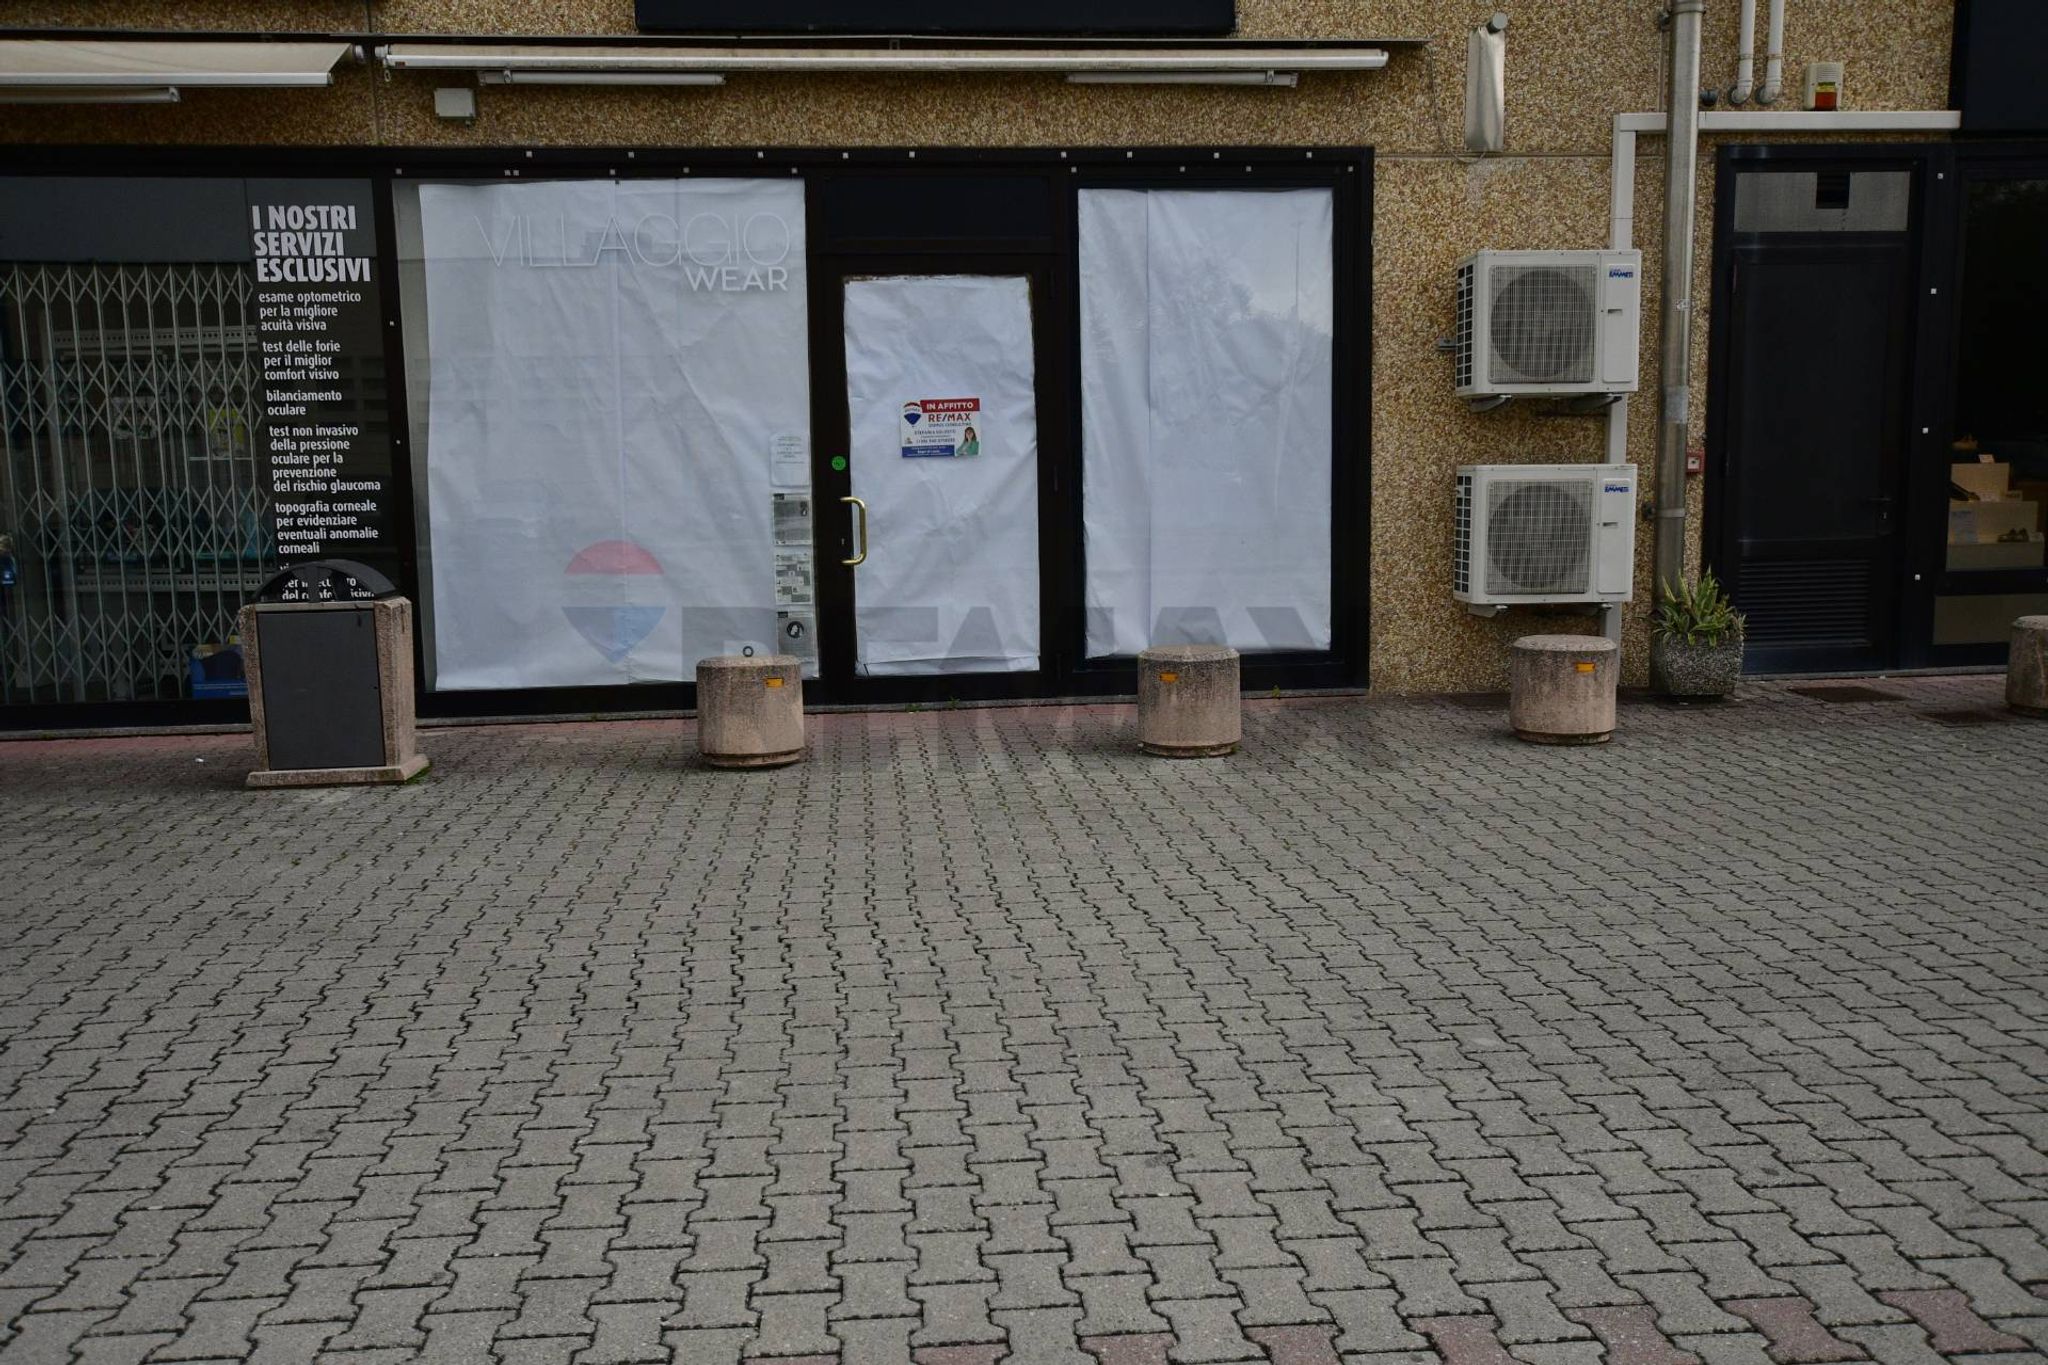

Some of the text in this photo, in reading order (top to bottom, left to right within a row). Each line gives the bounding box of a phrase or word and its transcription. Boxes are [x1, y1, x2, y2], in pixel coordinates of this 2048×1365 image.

[252, 205, 356, 230] I NOSTRI
[254, 232, 344, 256] SERVIZI
[474, 211, 790, 267] VILLAGGIO
[256, 257, 371, 282] ESCLUSIVI
[685, 266, 788, 292] WEAR
[258, 290, 361, 307] esame optometrico
[260, 304, 338, 320] per la migliore
[261, 318, 327, 331] acuità visiva
[262, 339, 341, 352] test delle forie
[263, 354, 332, 369] per il miglior
[264, 368, 340, 381] comfort visivo
[266, 389, 342, 402] bilanciamento
[267, 404, 306, 416] oculare
[937, 402, 974, 410] AFFITTO
[928, 413, 971, 422] RE/MAX
[269, 424, 358, 437] test non invasivo
[270, 438, 350, 453] della pressione
[271, 452, 343, 467] oculare per la
[272, 467, 337, 480] prevenzione
[274, 479, 381, 494] del rischio glaucoma
[275, 500, 377, 515] topografia corneale
[276, 514, 357, 529] per evidenziare
[277, 527, 379, 540] eventuali anomalie
[278, 541, 320, 554] corneali
